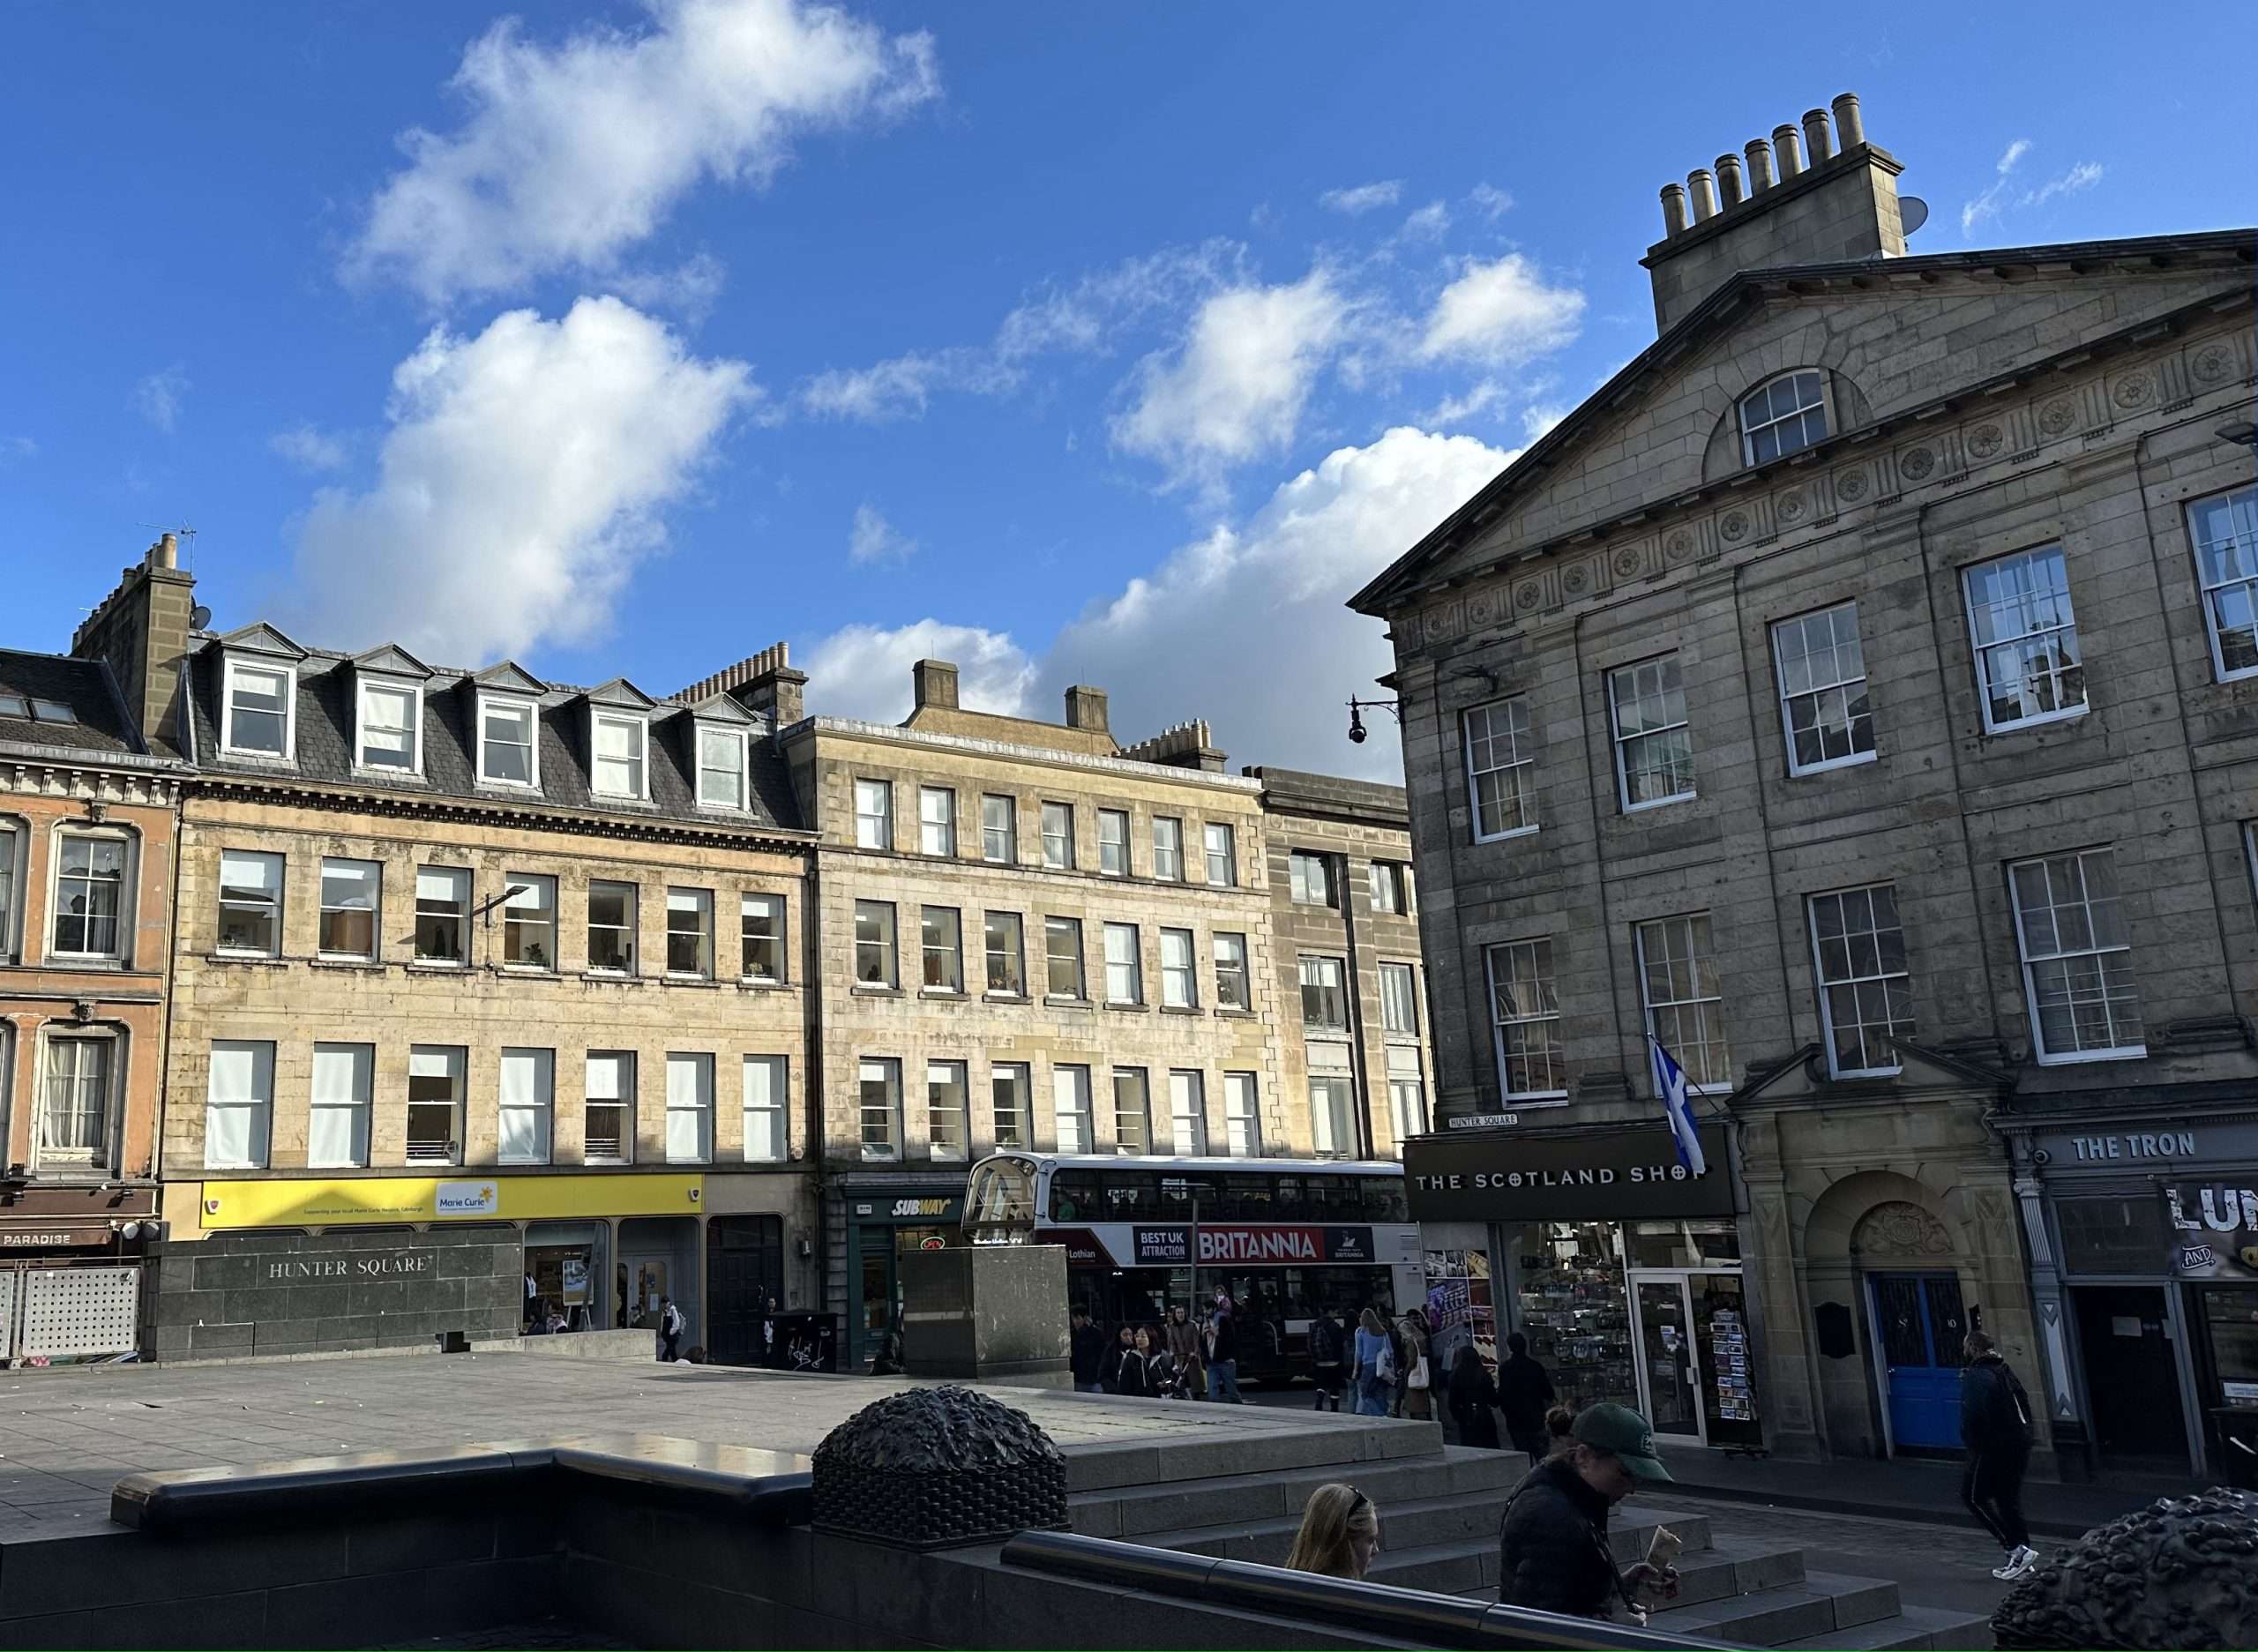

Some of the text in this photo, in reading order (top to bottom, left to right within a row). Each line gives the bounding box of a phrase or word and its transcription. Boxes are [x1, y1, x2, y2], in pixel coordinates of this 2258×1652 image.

[1451, 1115, 1516, 1127] HUNTER SQUARE
[2073, 1132, 2195, 1159] THE TRON
[1416, 1175, 1462, 1191] THE
[1475, 1169, 1614, 1188] SCOTLAND
[439, 1198, 485, 1207] Marie Curie
[892, 1198, 952, 1216] SUBWAY
[4, 1235, 71, 1245] PARADISE
[1140, 1232, 1185, 1244] BEST UK
[1141, 1245, 1185, 1257] ATTRACTION
[1199, 1232, 1317, 1260] BRITANNIA
[1068, 1249, 1096, 1259] Lothian
[2185, 1248, 2211, 1266] AND
[269, 1257, 427, 1278] HUNTER SQUARE
